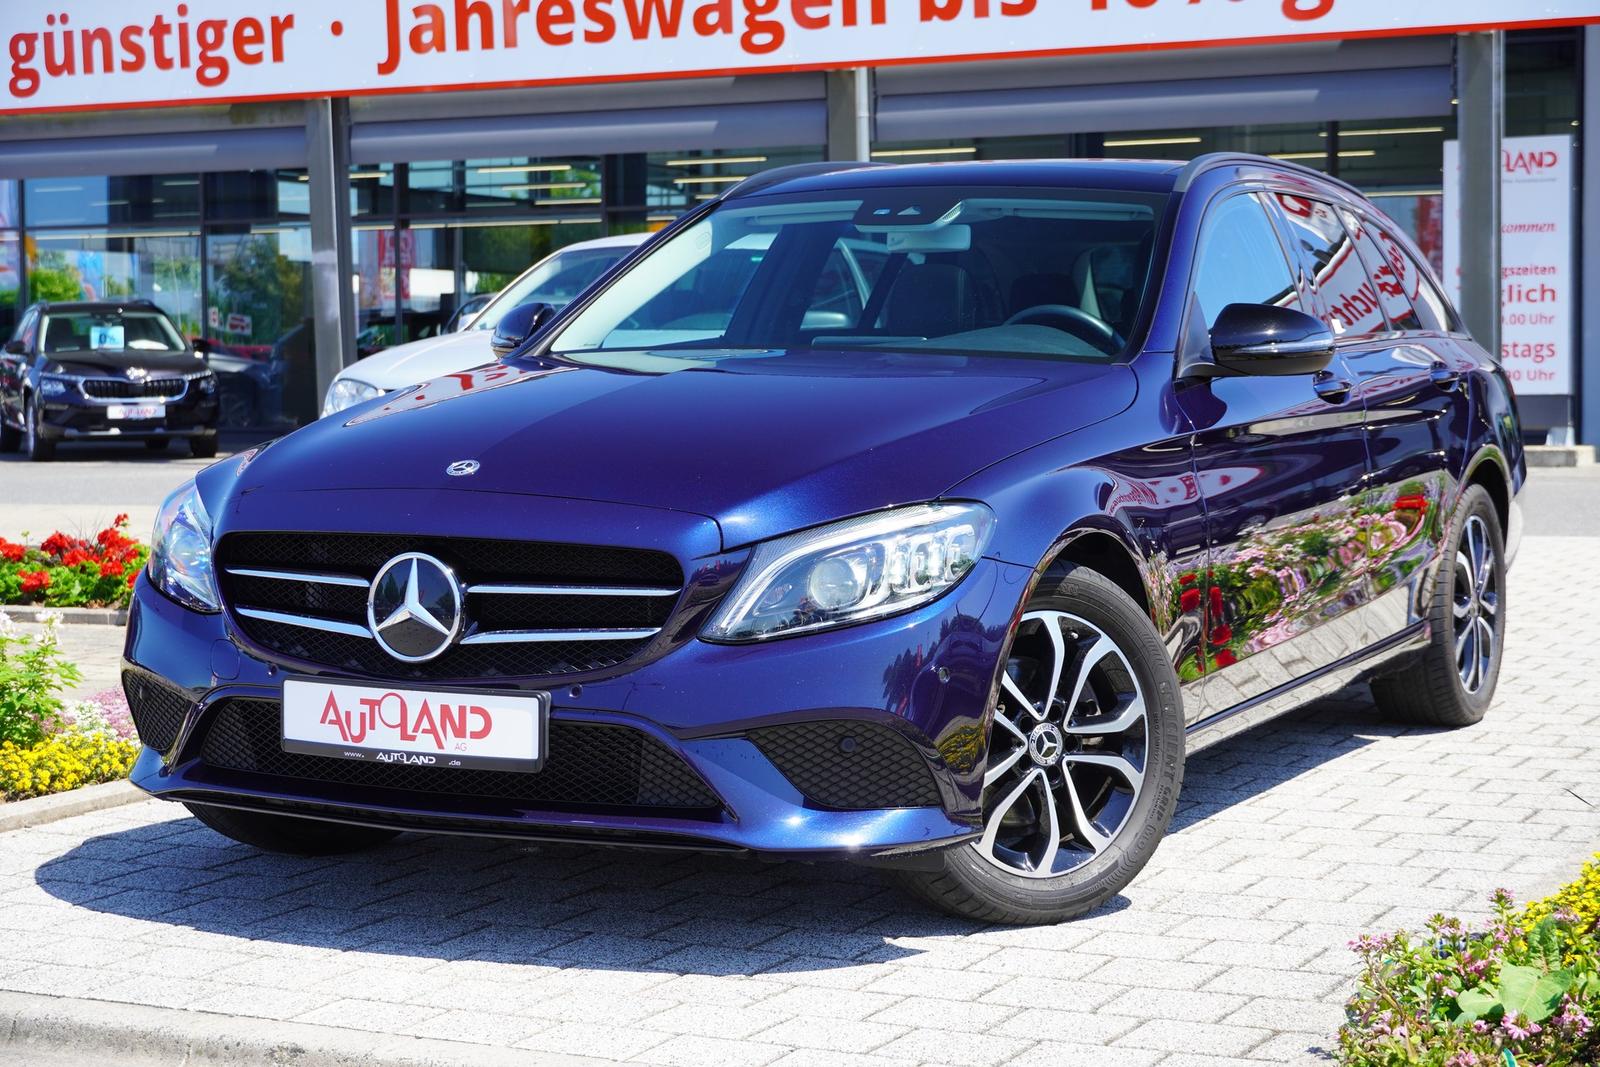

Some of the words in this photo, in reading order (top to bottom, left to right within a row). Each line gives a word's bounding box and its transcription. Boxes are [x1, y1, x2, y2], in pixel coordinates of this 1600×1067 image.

[8, 3, 294, 98] günstiger
[377, 0, 887, 75] Jahreswagen
[1500, 222, 1556, 234] ommen
[1501, 265, 1556, 279] gszeiten
[1501, 283, 1556, 305] lich
[1529, 313, 1555, 325] Uhr
[1501, 341, 1555, 364] stags
[1527, 369, 1555, 381] Uhr
[454, 742, 467, 752] AG
